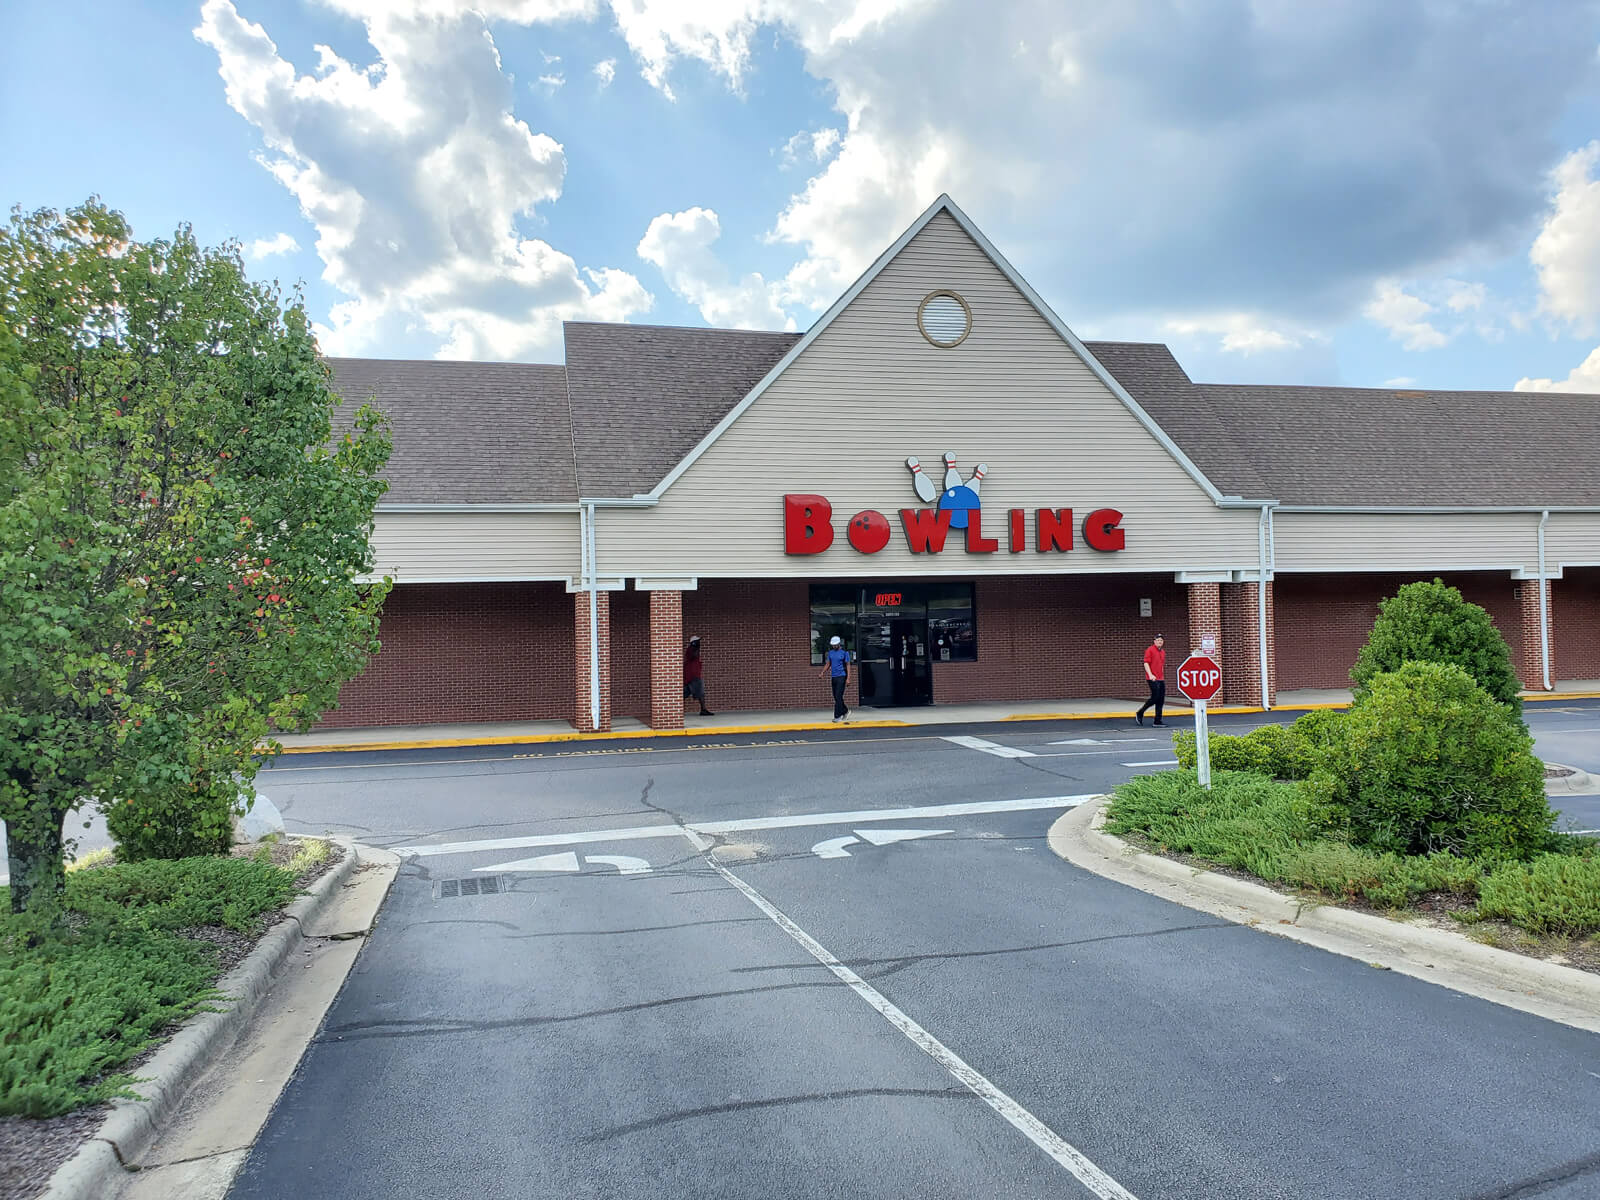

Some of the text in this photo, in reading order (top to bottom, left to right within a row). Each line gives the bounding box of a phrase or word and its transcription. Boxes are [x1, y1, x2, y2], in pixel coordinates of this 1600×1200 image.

[783, 494, 1126, 555] BOWLING
[875, 593, 902, 606] OPEN
[1180, 670, 1219, 687] STOP
